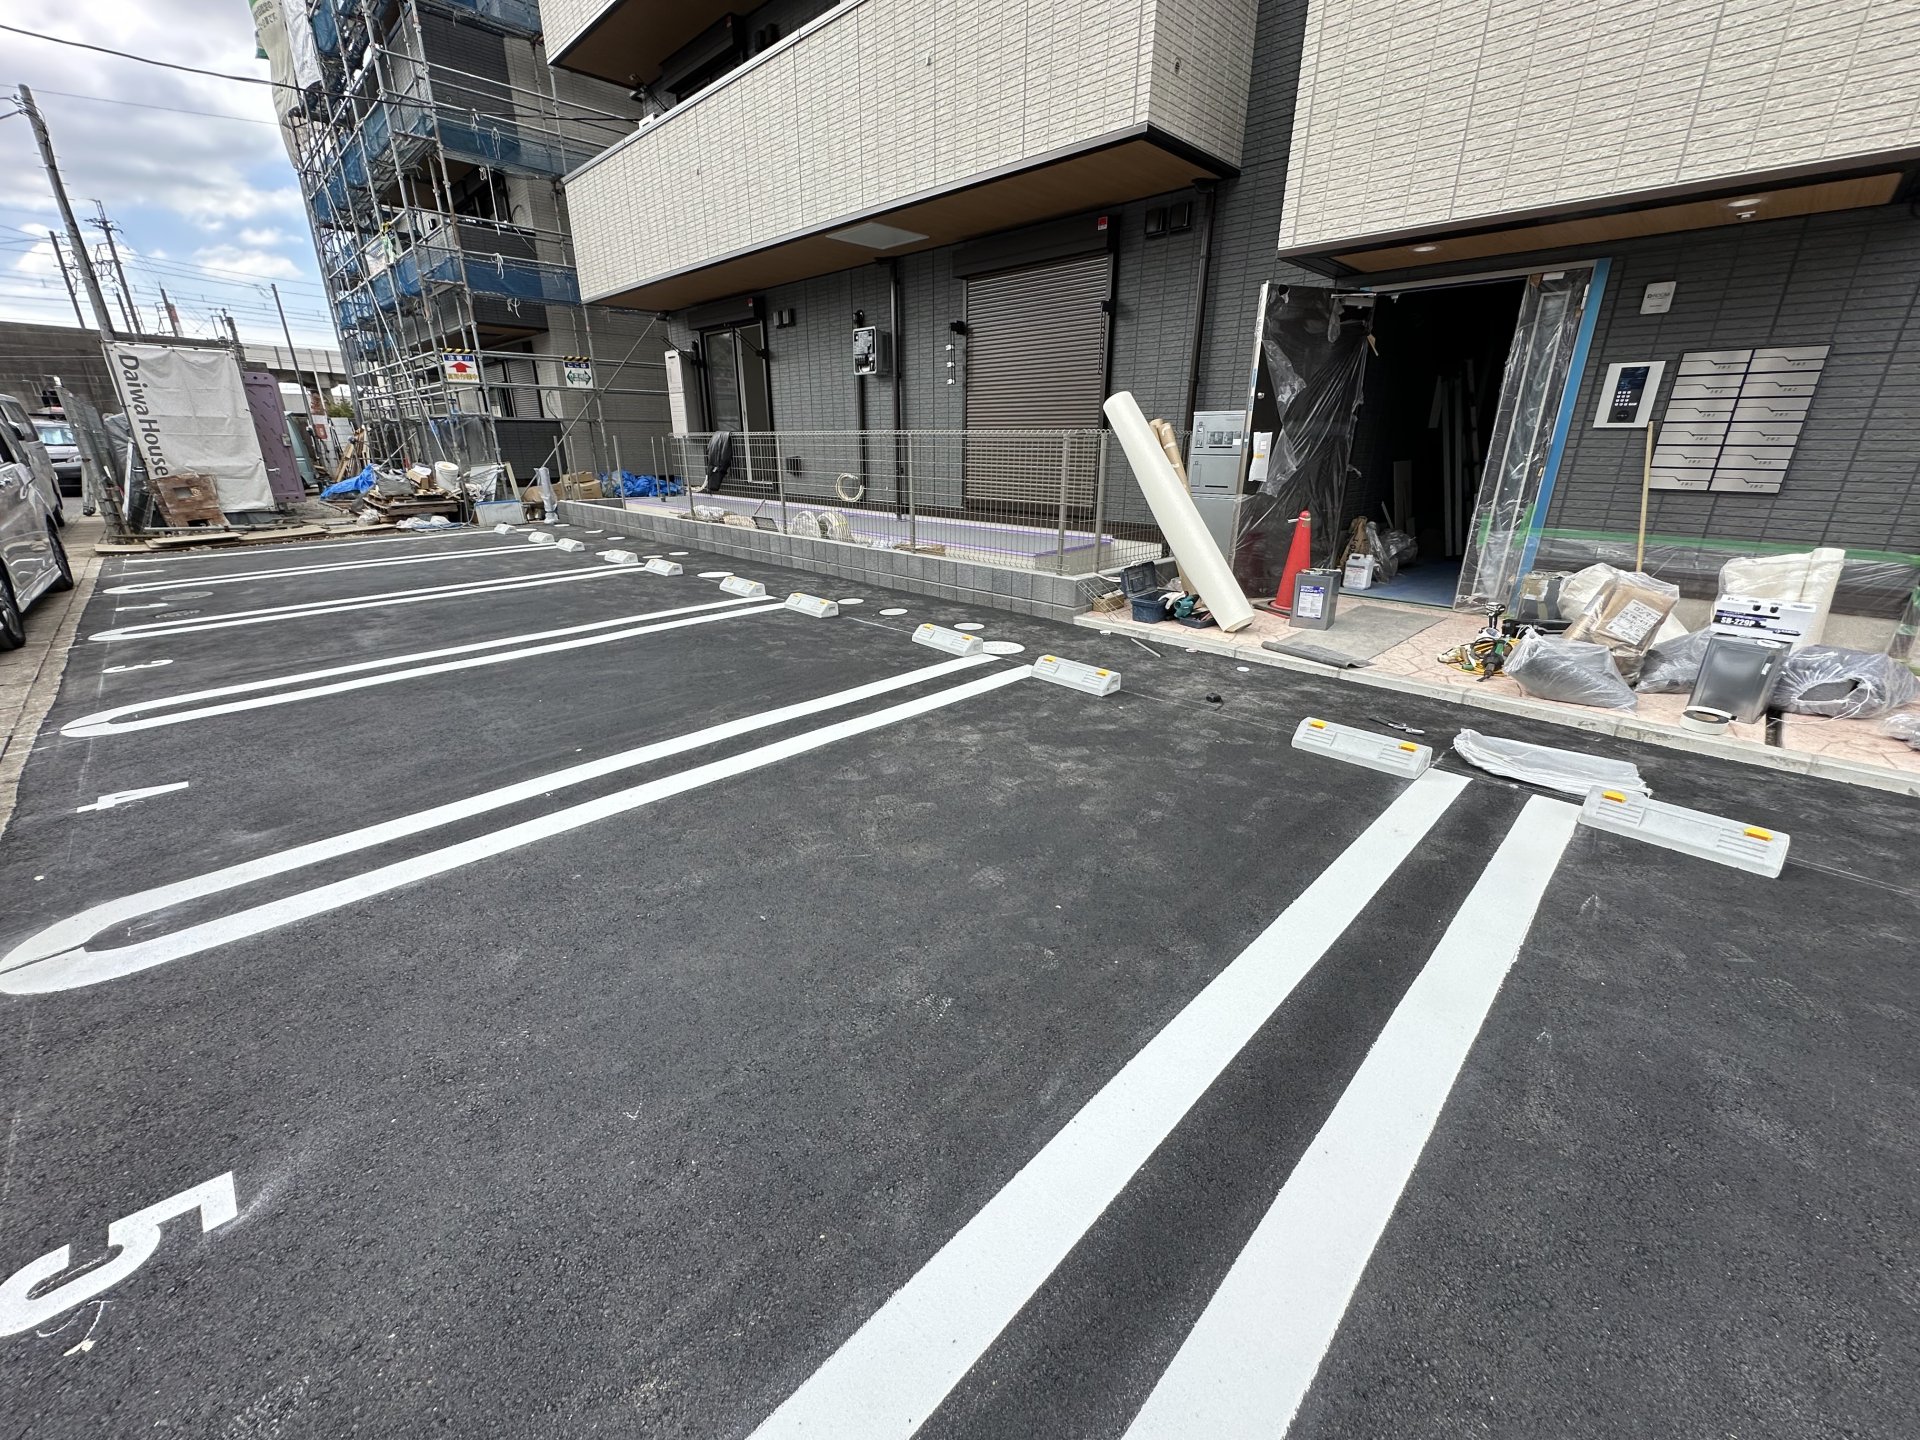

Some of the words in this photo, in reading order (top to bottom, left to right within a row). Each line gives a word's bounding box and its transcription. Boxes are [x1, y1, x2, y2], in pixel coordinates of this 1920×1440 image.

[118, 354, 149, 416] Daiwa
[139, 419, 169, 477] House
[1720, 616, 1756, 627] SB-229P
[77, 781, 189, 814] 4
[0, 1170, 238, 1337] 5
